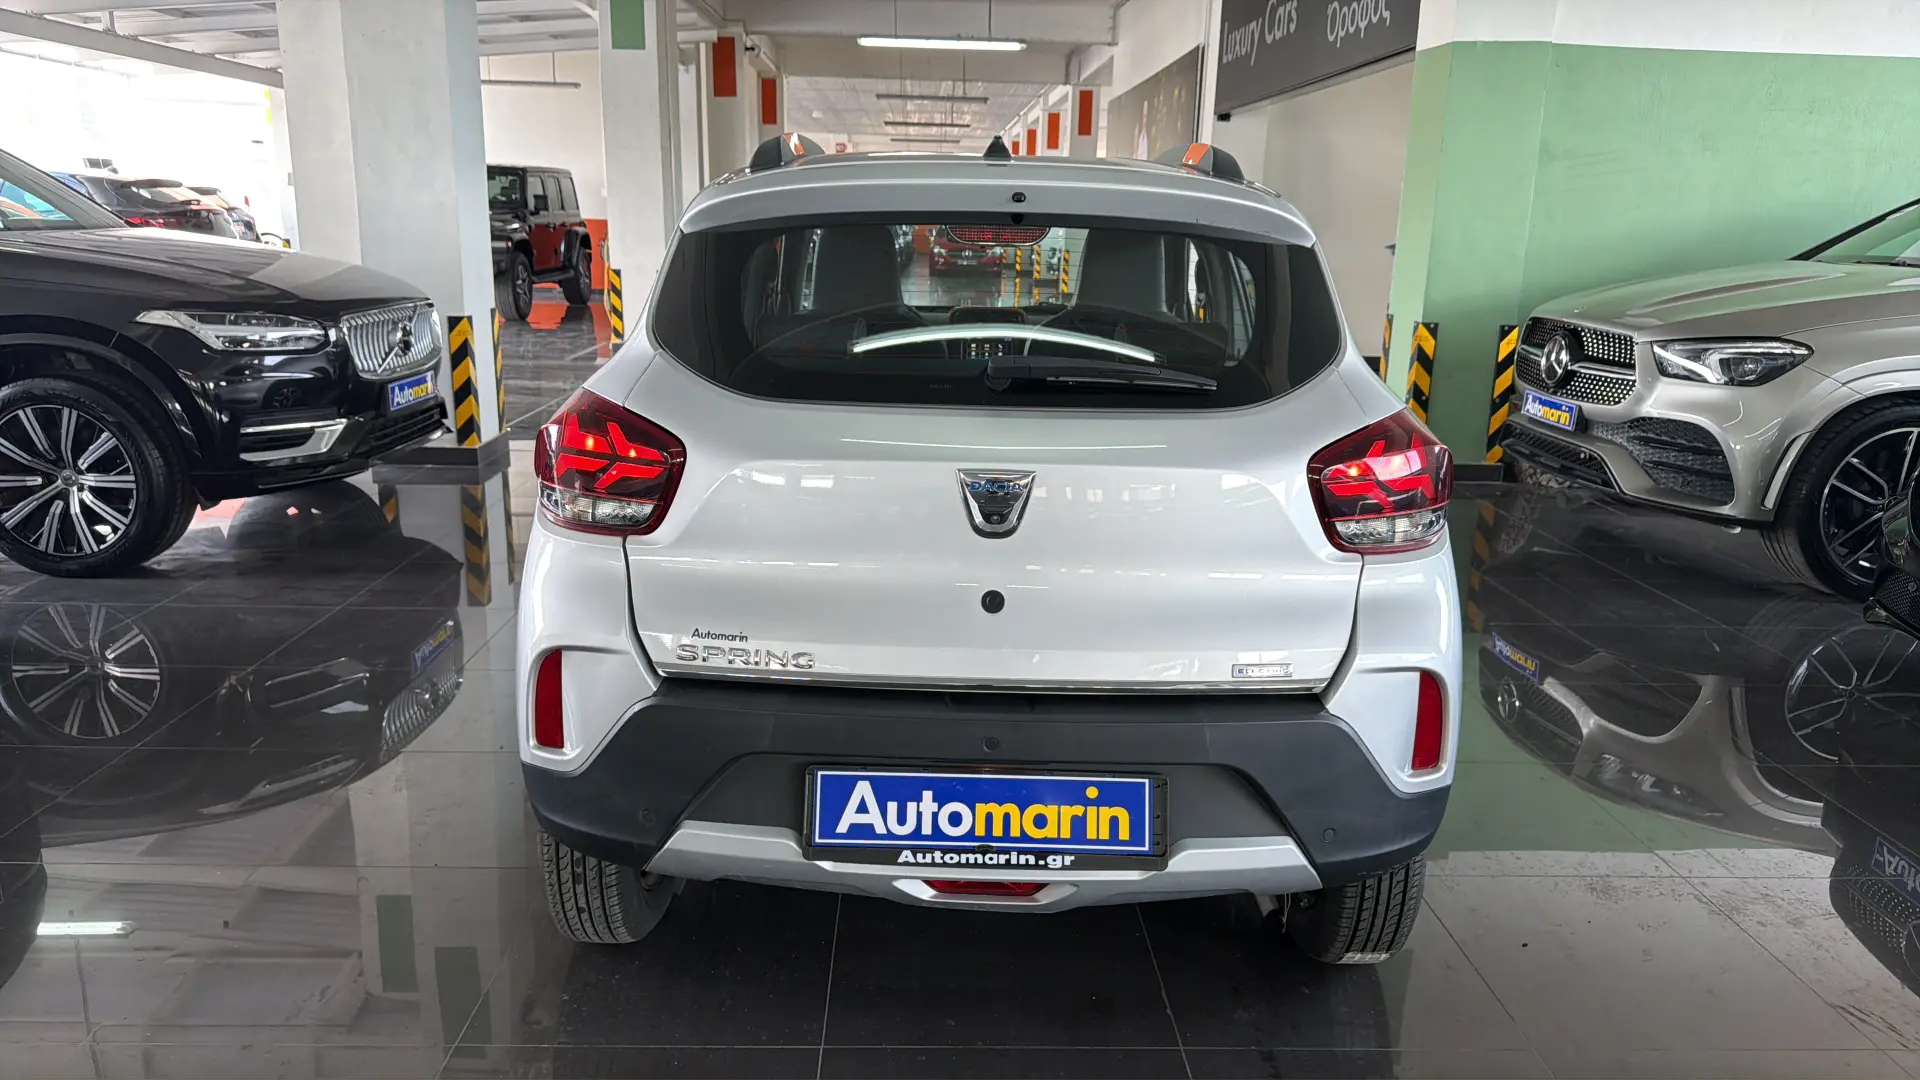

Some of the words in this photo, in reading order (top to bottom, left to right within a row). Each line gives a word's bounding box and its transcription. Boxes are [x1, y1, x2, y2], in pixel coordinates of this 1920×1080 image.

[1222, 17, 1262, 66] Luxury
[1265, 0, 1298, 44] Cars
[1524, 394, 1571, 425] Automarin
[969, 481, 1024, 492] DACIA
[691, 627, 748, 643] Automarin
[675, 643, 816, 669] SPRING
[835, 780, 1130, 841] Automarin
[897, 849, 1075, 869] Automarin.gr
